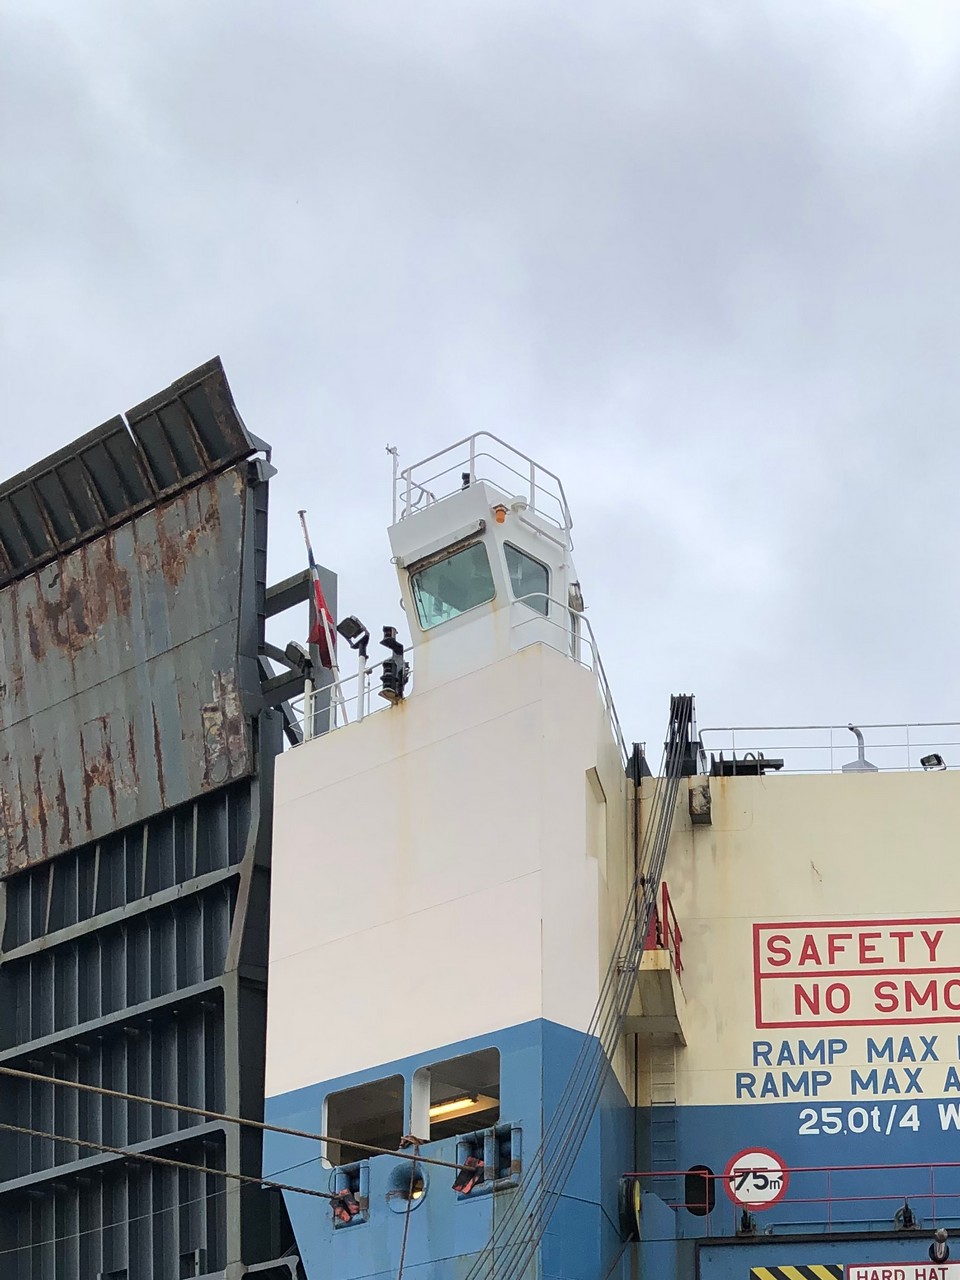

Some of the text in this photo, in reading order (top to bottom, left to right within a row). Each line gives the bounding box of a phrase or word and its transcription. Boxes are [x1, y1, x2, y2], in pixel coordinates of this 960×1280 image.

[766, 930, 944, 966] SAFETY
[794, 983, 851, 1015] NO
[752, 1039, 848, 1067] RAMP
[866, 1036, 939, 1063] MAX
[735, 1070, 832, 1099] RAMP
[850, 1067, 924, 1096] MAX
